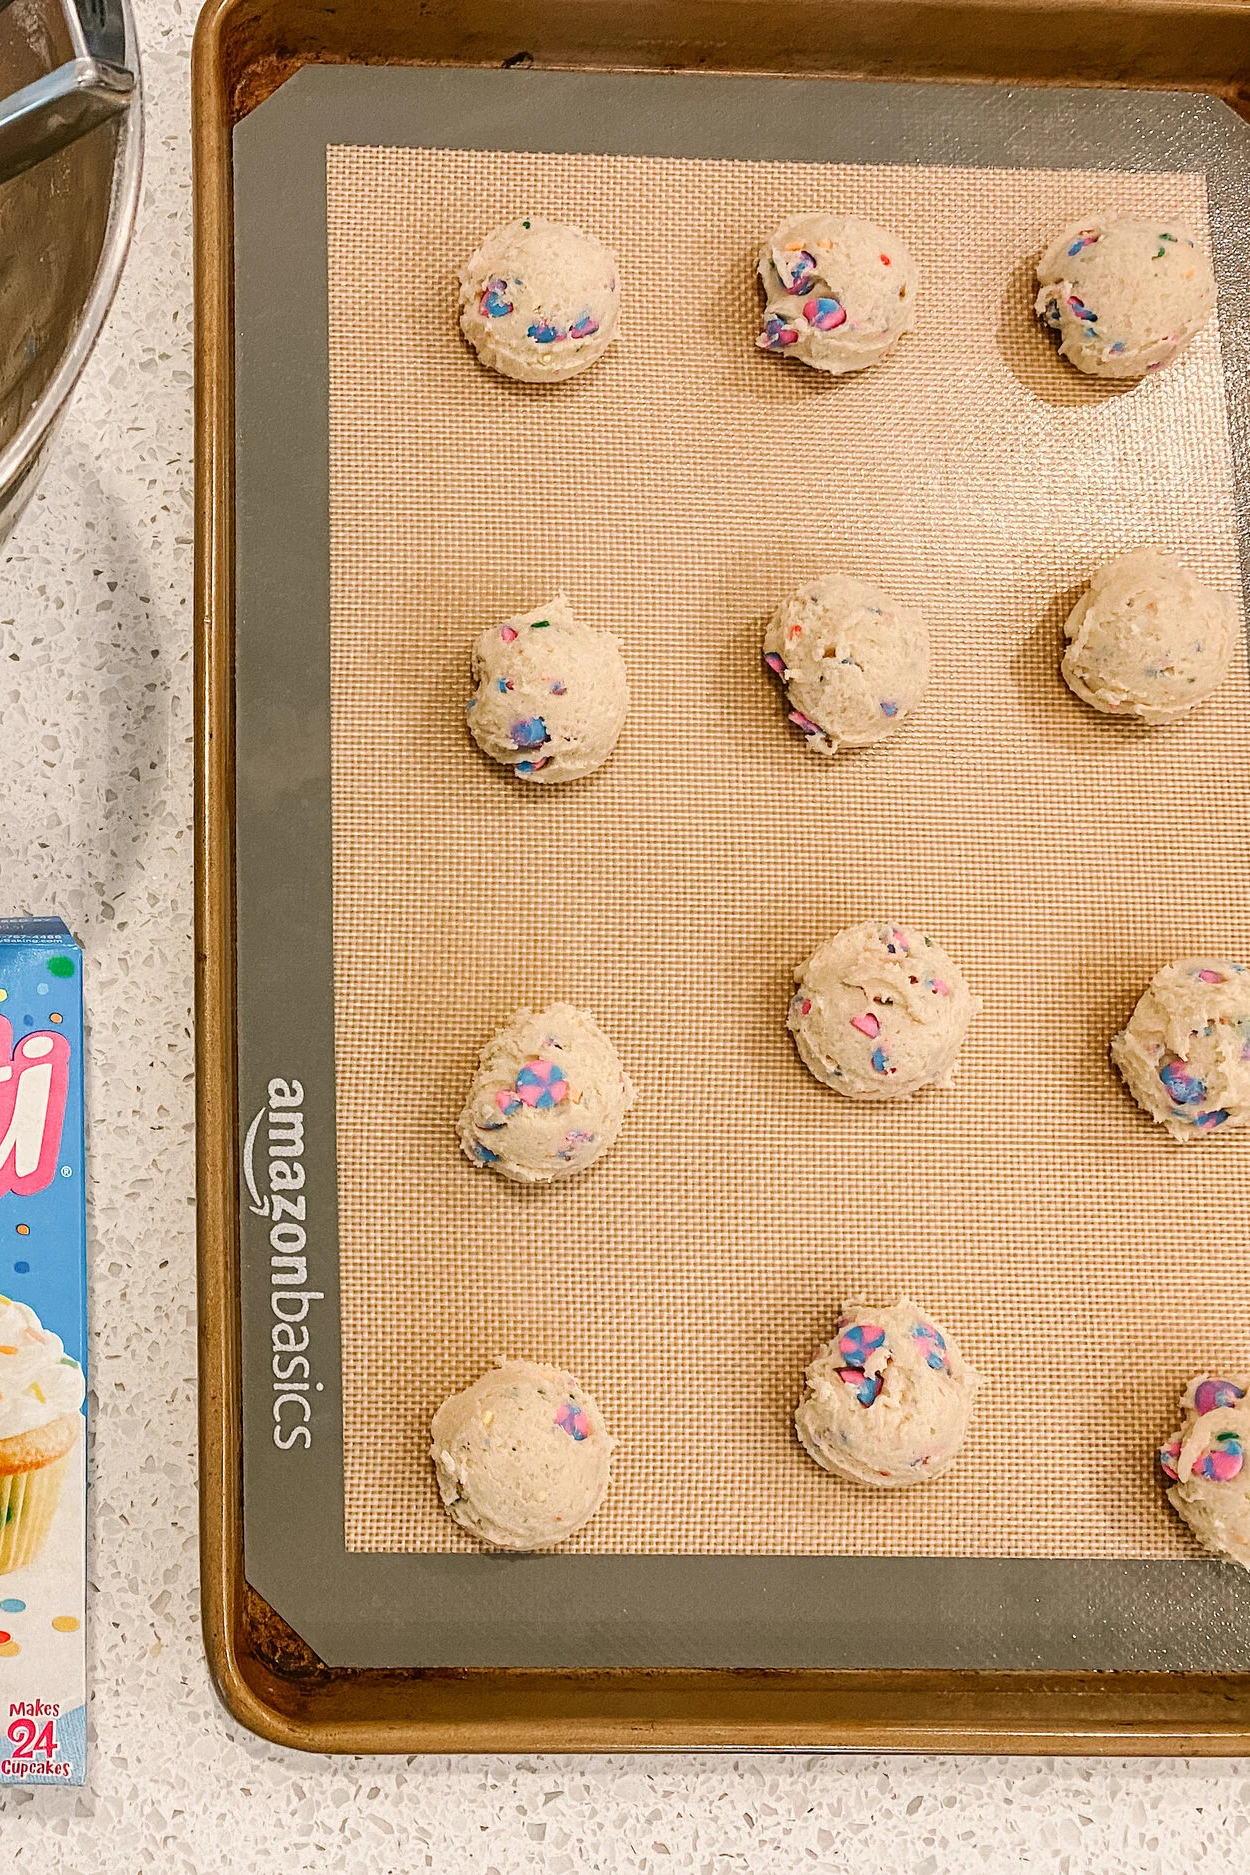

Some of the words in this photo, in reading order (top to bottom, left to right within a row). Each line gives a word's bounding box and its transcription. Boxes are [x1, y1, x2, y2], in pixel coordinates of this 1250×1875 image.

[9, 1699, 60, 1718] Makes
[7, 1718, 58, 1759] 24
[1, 1760, 70, 1778] Cupcakes
